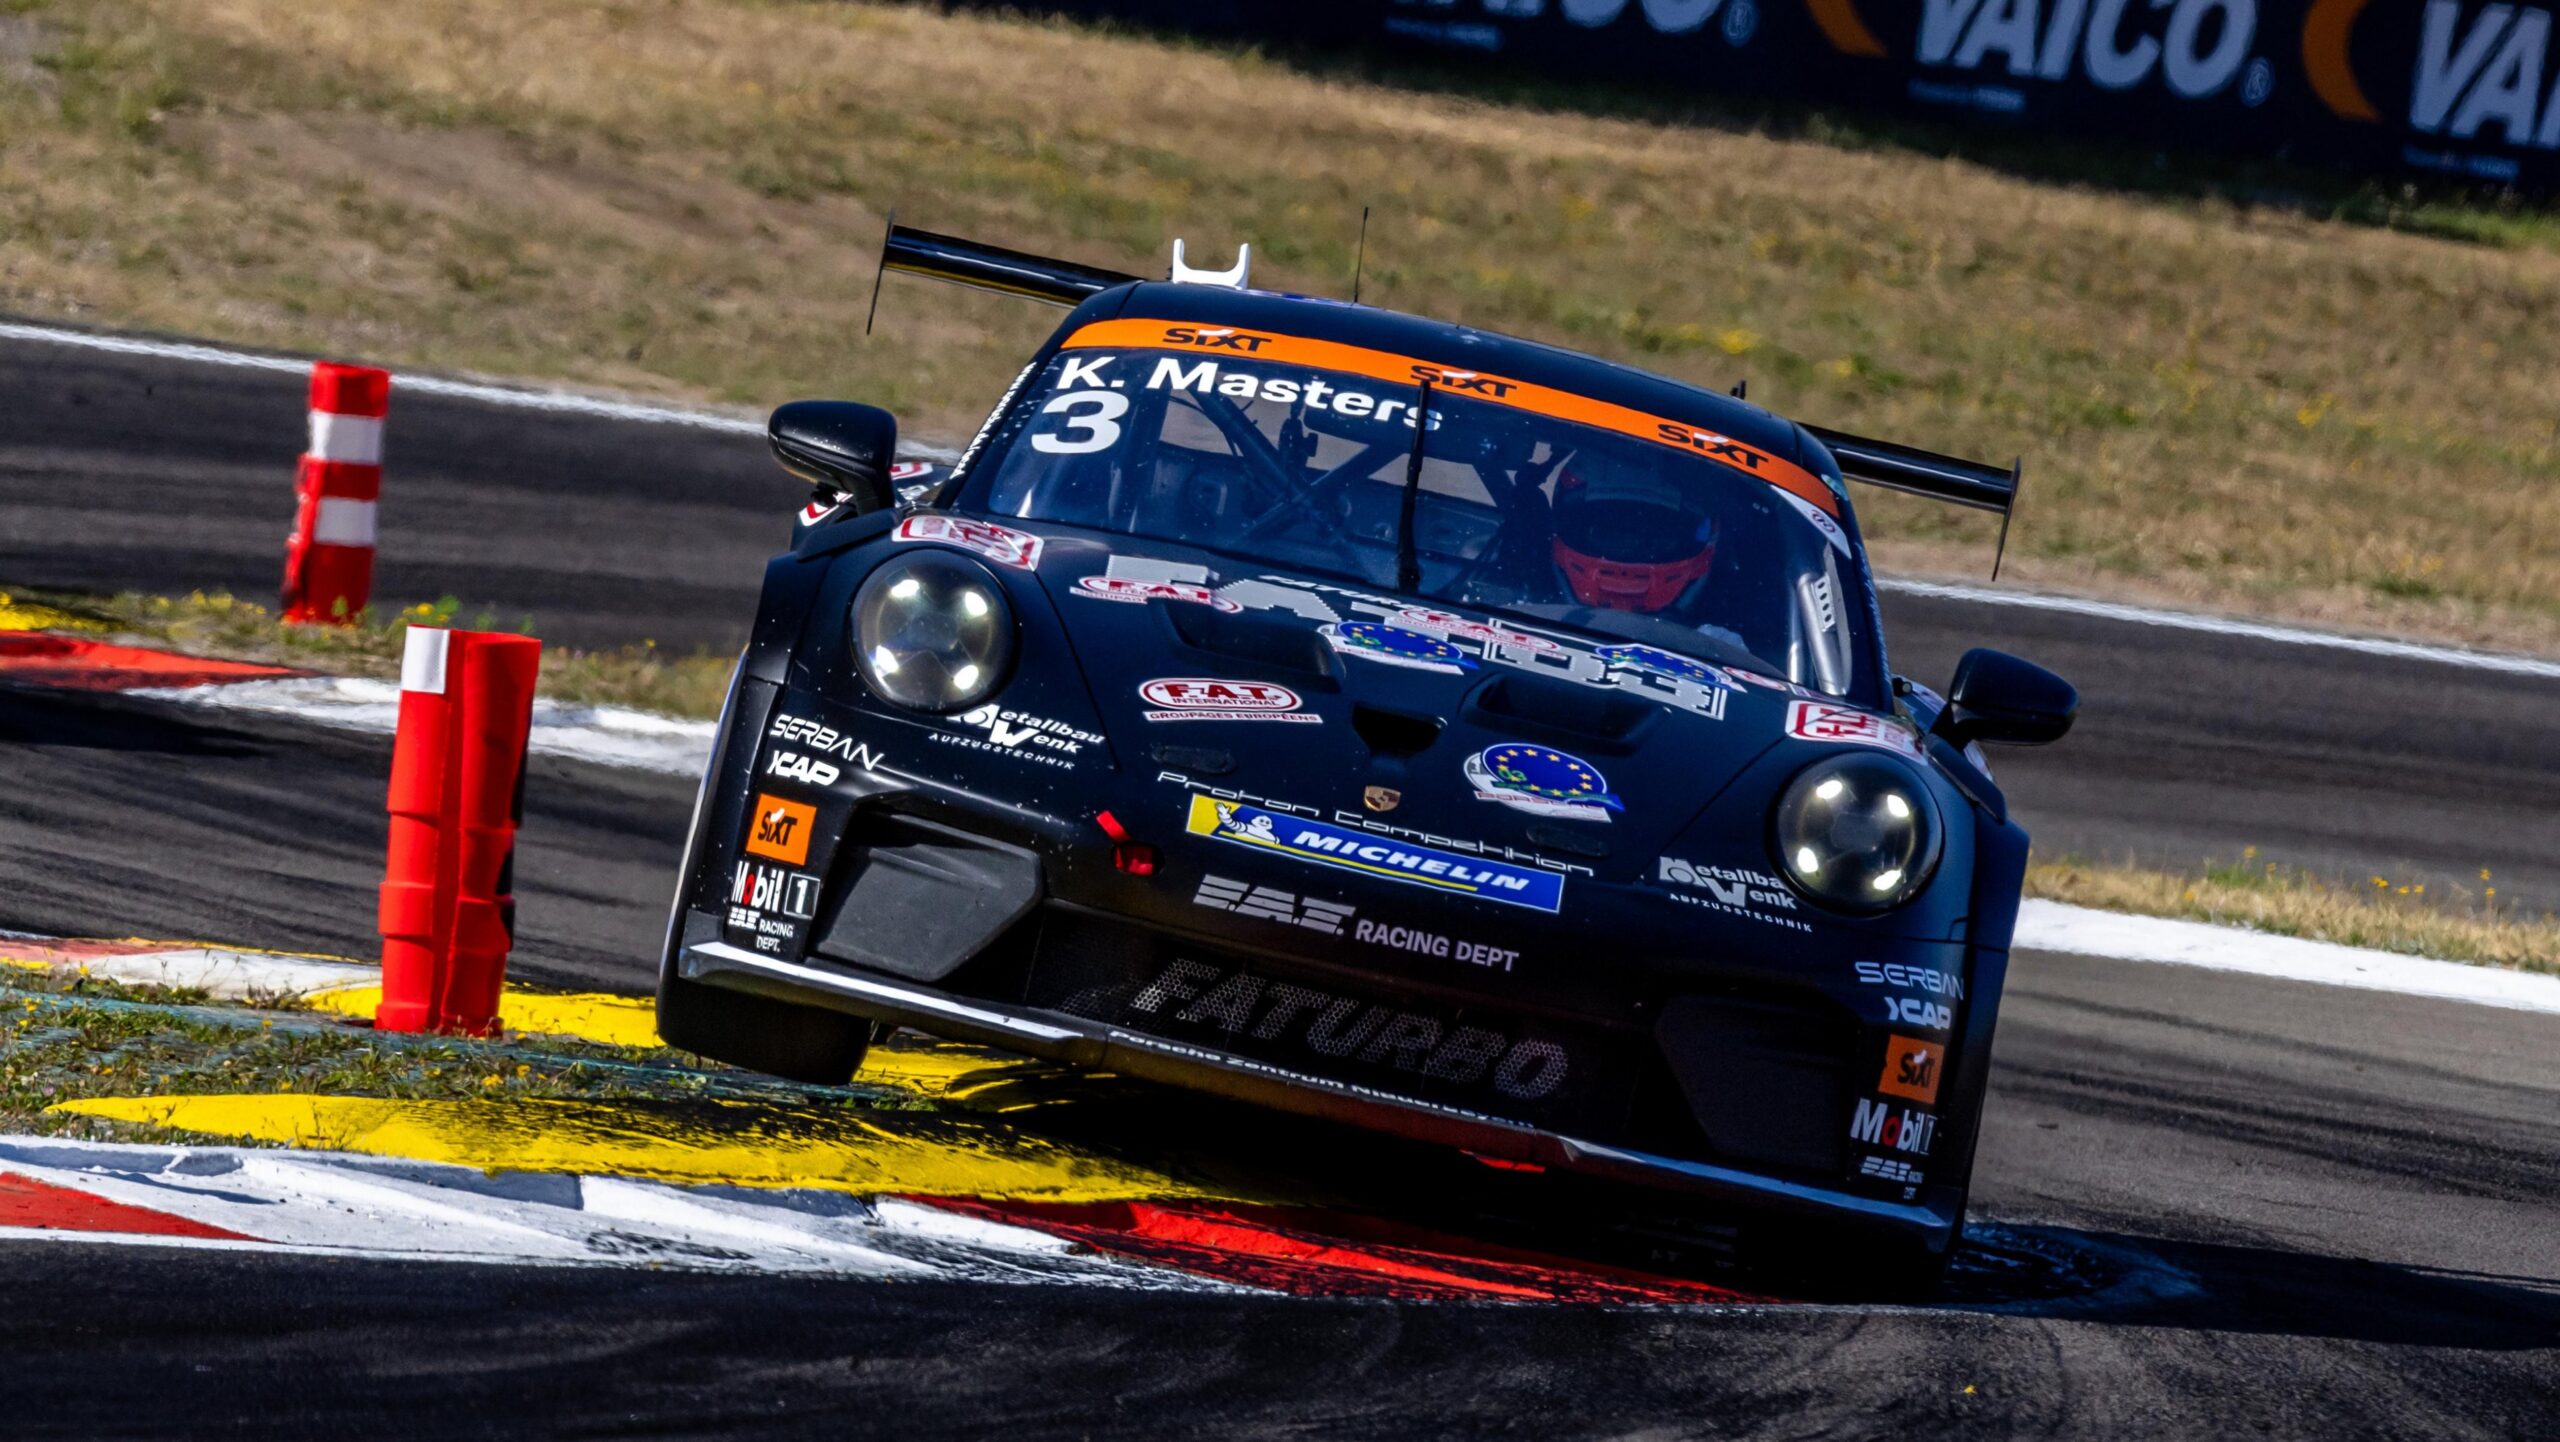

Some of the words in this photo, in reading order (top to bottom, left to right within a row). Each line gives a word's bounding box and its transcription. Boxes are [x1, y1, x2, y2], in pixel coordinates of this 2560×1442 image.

[1055, 356, 1123, 390] K.
[1145, 357, 1442, 431] Masters
[1031, 391, 1128, 454] 3
[1149, 712, 1233, 721] GROUPAGES
[1173, 697, 1281, 707] INTERNATIONAL
[769, 713, 885, 771] SERBAN
[928, 733, 1075, 771] AUFZUGSTECHNIK
[989, 719, 1083, 754] Wenk
[1157, 771, 1320, 817] Proton
[1335, 810, 1594, 877] Competition
[731, 860, 785, 913] Mobil
[795, 879, 809, 914] 1
[1293, 831, 1530, 891] MICHELIN
[758, 918, 794, 938] RACING
[1669, 892, 1814, 933] AUFZUGSTECHNIK
[1354, 919, 1449, 958] RACING
[1455, 940, 1520, 972] DEPT
[1855, 961, 1965, 1001] SERBAN
[1132, 958, 1568, 1101] FATURBO
[1226, 1057, 1344, 1089] Zentrum
[1850, 1097, 1925, 1153] Mobil
